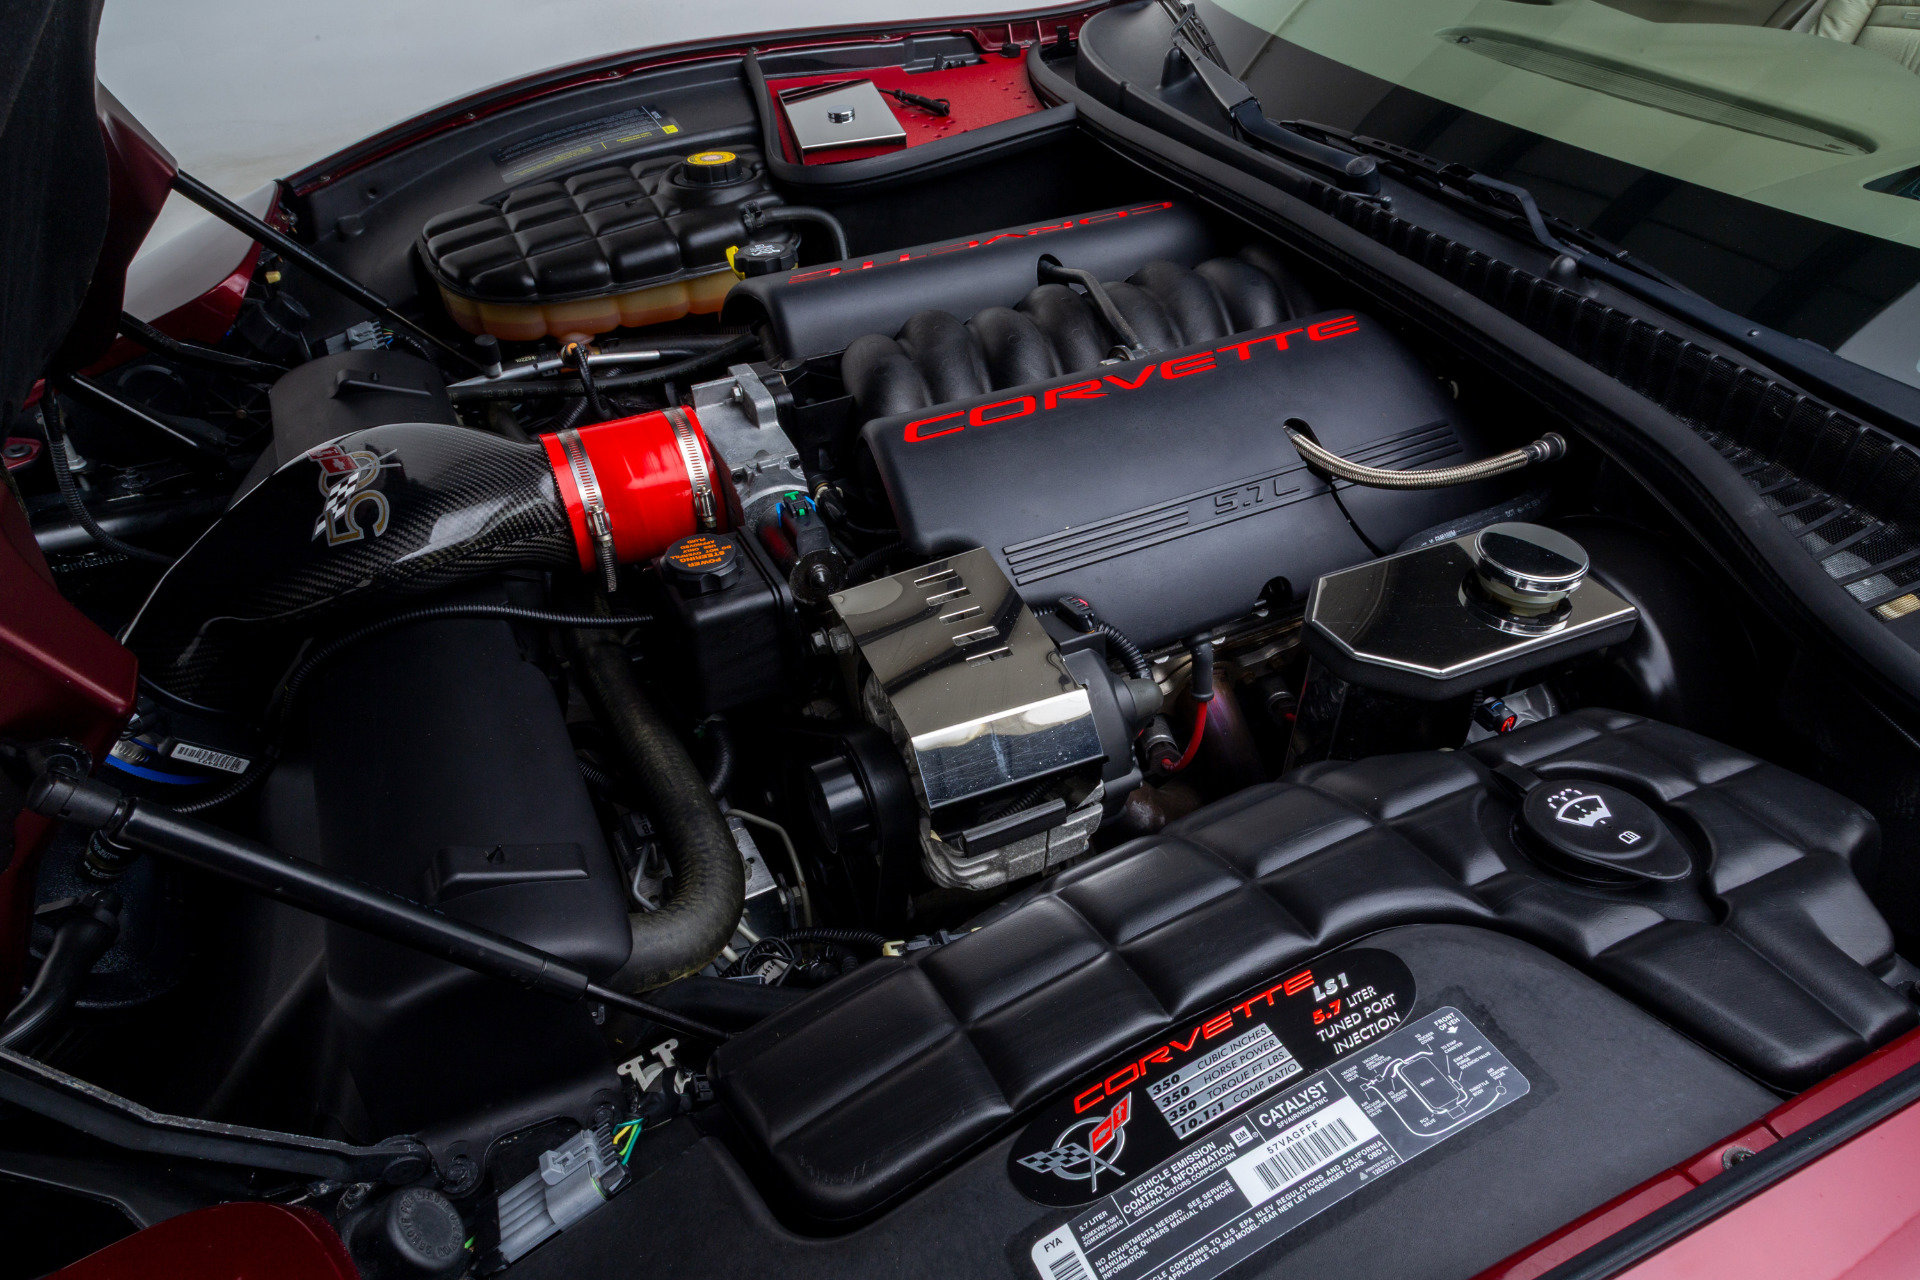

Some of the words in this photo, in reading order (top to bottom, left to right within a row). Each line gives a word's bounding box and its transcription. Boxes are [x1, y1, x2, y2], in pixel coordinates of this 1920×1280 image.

[903, 315, 1360, 443] CORVETTE
[679, 551, 725, 563] STEERING
[680, 540, 715, 550] APPROVED
[688, 558, 721, 567] POWER
[1313, 972, 1349, 1002] LS1
[1313, 999, 1341, 1025] 5.7
[1346, 986, 1377, 1007] LITER
[1316, 1013, 1362, 1041] TUNED
[1363, 993, 1396, 1018] PORT
[1333, 1012, 1400, 1054] INJECTION
[1434, 1012, 1455, 1026] FRONT
[1439, 1023, 1447, 1031] OF
[1447, 1017, 1460, 1026] VEH
[1073, 970, 1315, 1115] CORVETTE
[1153, 1074, 1180, 1095] 350
[1197, 1048, 1228, 1070] CUBIC
[1230, 1027, 1267, 1052] INCHES
[1162, 1086, 1190, 1107] 350
[1204, 1060, 1237, 1084] HORSE
[1239, 1039, 1276, 1064] POWER
[1169, 1100, 1197, 1121] 350
[1206, 1071, 1249, 1099] TORQUE
[1252, 1062, 1264, 1075] FT.
[1267, 1051, 1286, 1066] LBS.
[1180, 1102, 1224, 1134] 10.1:1
[1233, 1081, 1264, 1103] COMP.
[1267, 1063, 1297, 1084] RATIO
[1259, 1080, 1328, 1127] CATALYST
[1235, 1130, 1247, 1141] GM
[1266, 1120, 1317, 1154] 57VAGFFF
[1123, 1183, 1169, 1214] CONTROL
[1170, 1142, 1235, 1185] INFORMATION
[1130, 1168, 1171, 1197] VEHICLE
[1171, 1141, 1216, 1173] EMISSION
[1134, 1196, 1164, 1217] GENERAL
[1164, 1179, 1191, 1198] MOTORS
[1191, 1152, 1236, 1181] CORPORATION
[1079, 1222, 1088, 1232] 5.7
[1089, 1211, 1108, 1226] LITER
[1095, 1257, 1106, 1267] NO
[1108, 1227, 1155, 1260] ADJUSTMENTS
[1155, 1209, 1185, 1229] NEEDED.
[1187, 1197, 1202, 1209] SEE
[1202, 1180, 1231, 1200] SERVICE
[1169, 1244, 1209, 1273] CONFORMS
[1210, 1237, 1221, 1246] TO
[1222, 1228, 1237, 1239] U.S.
[1239, 1217, 1254, 1229] EPA
[1255, 1204, 1274, 1219] NLEV
[1276, 1174, 1324, 1206] REGULATIONS
[1326, 1164, 1341, 1176] AND
[1342, 1140, 1383, 1166] CALIFORNIA
[1208, 1247, 1219, 1256] TO
[1219, 1237, 1235, 1250] 2003
[1235, 1210, 1278, 1240] MODEL-YEAR
[1277, 1201, 1294, 1213] NEW
[1293, 1192, 1307, 1204] LEV
[1307, 1170, 1346, 1196] PASSENGER
[1345, 1159, 1366, 1173] CARS.
[1367, 1149, 1382, 1160] OBD
[1044, 1238, 1062, 1252] FYA
[1098, 1253, 1128, 1274] MANUAL
[1128, 1245, 1139, 1254] OR
[1140, 1226, 1170, 1247] OWNERS
[1170, 1209, 1198, 1228] MANUAL
[1198, 1198, 1214, 1210] FOR
[1214, 1186, 1235, 1201] MORE
[1102, 1249, 1148, 1280] INFORMATION.
